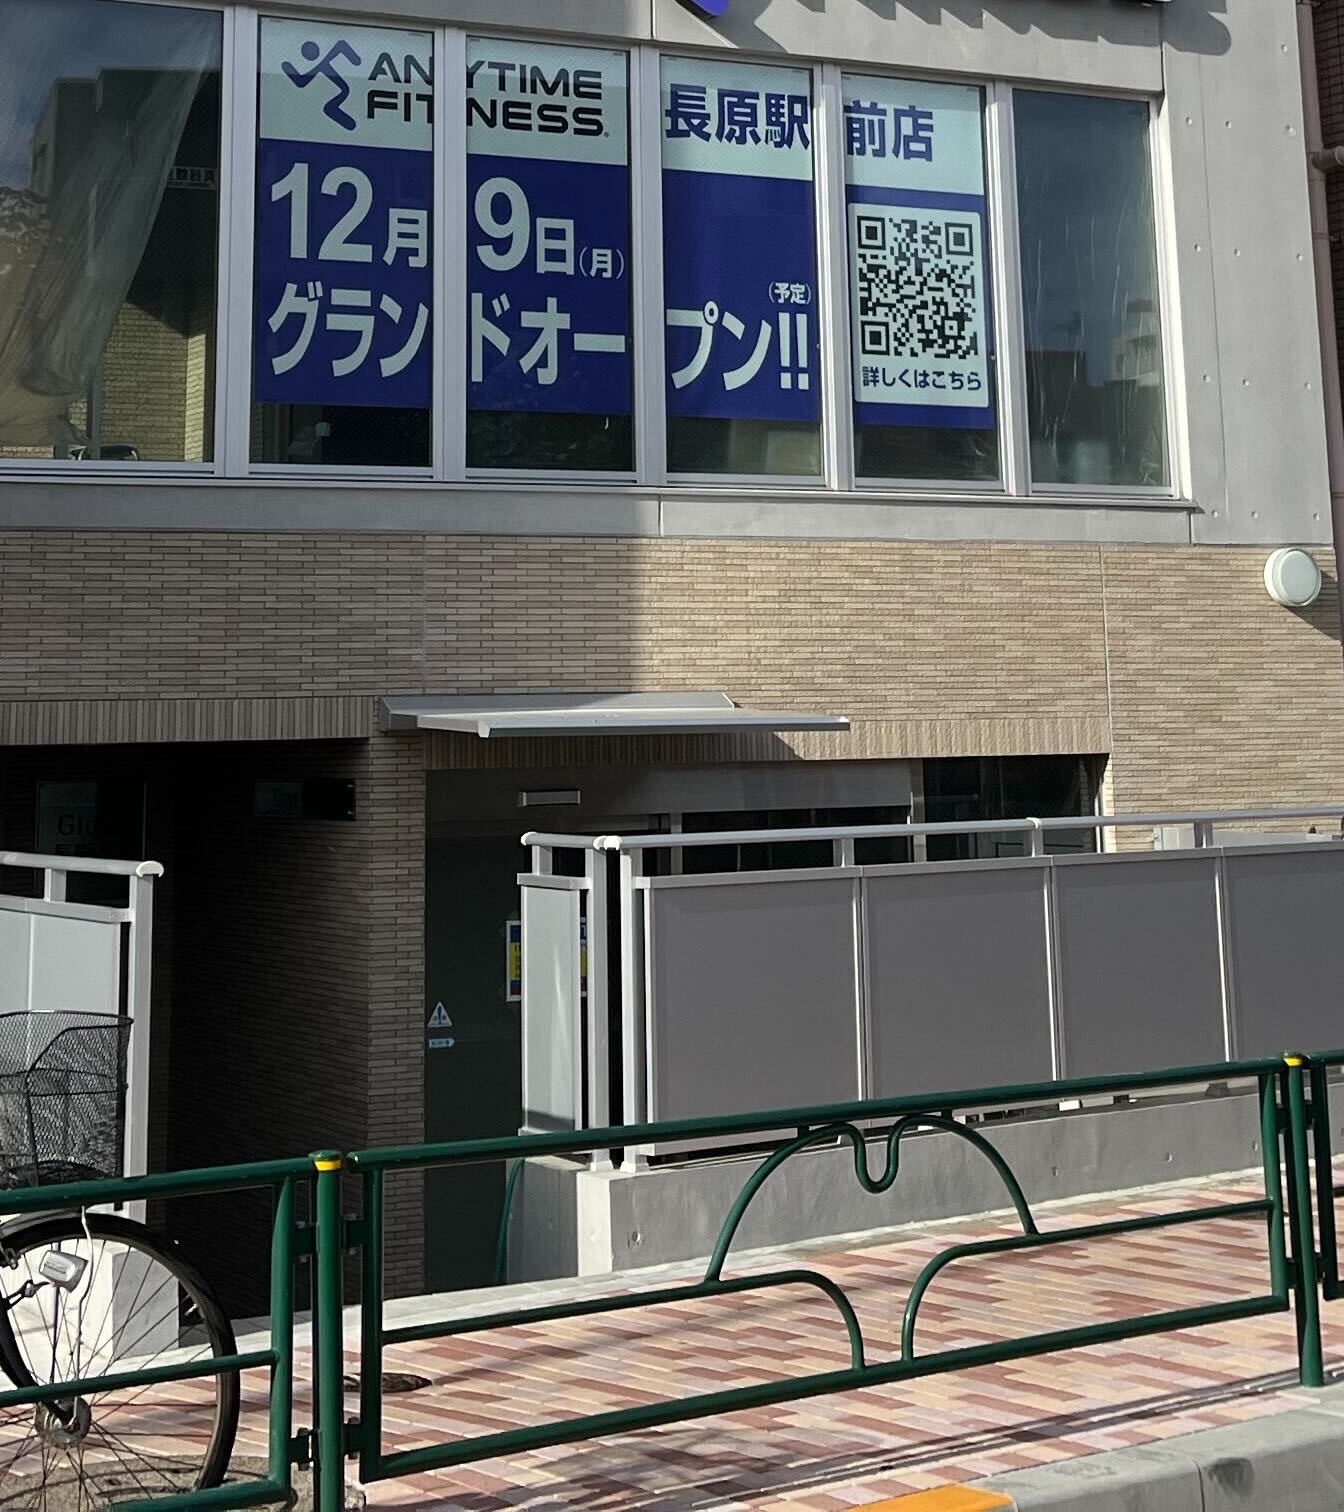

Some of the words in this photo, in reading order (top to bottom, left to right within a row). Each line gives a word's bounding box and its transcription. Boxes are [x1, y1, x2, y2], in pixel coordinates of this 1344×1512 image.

[368, 52, 603, 100] ANYTIME
[367, 89, 603, 136] FITNESS
[664, 83, 935, 162] 長原駅前店
[862, 365, 982, 391] 詳しくはこちら
